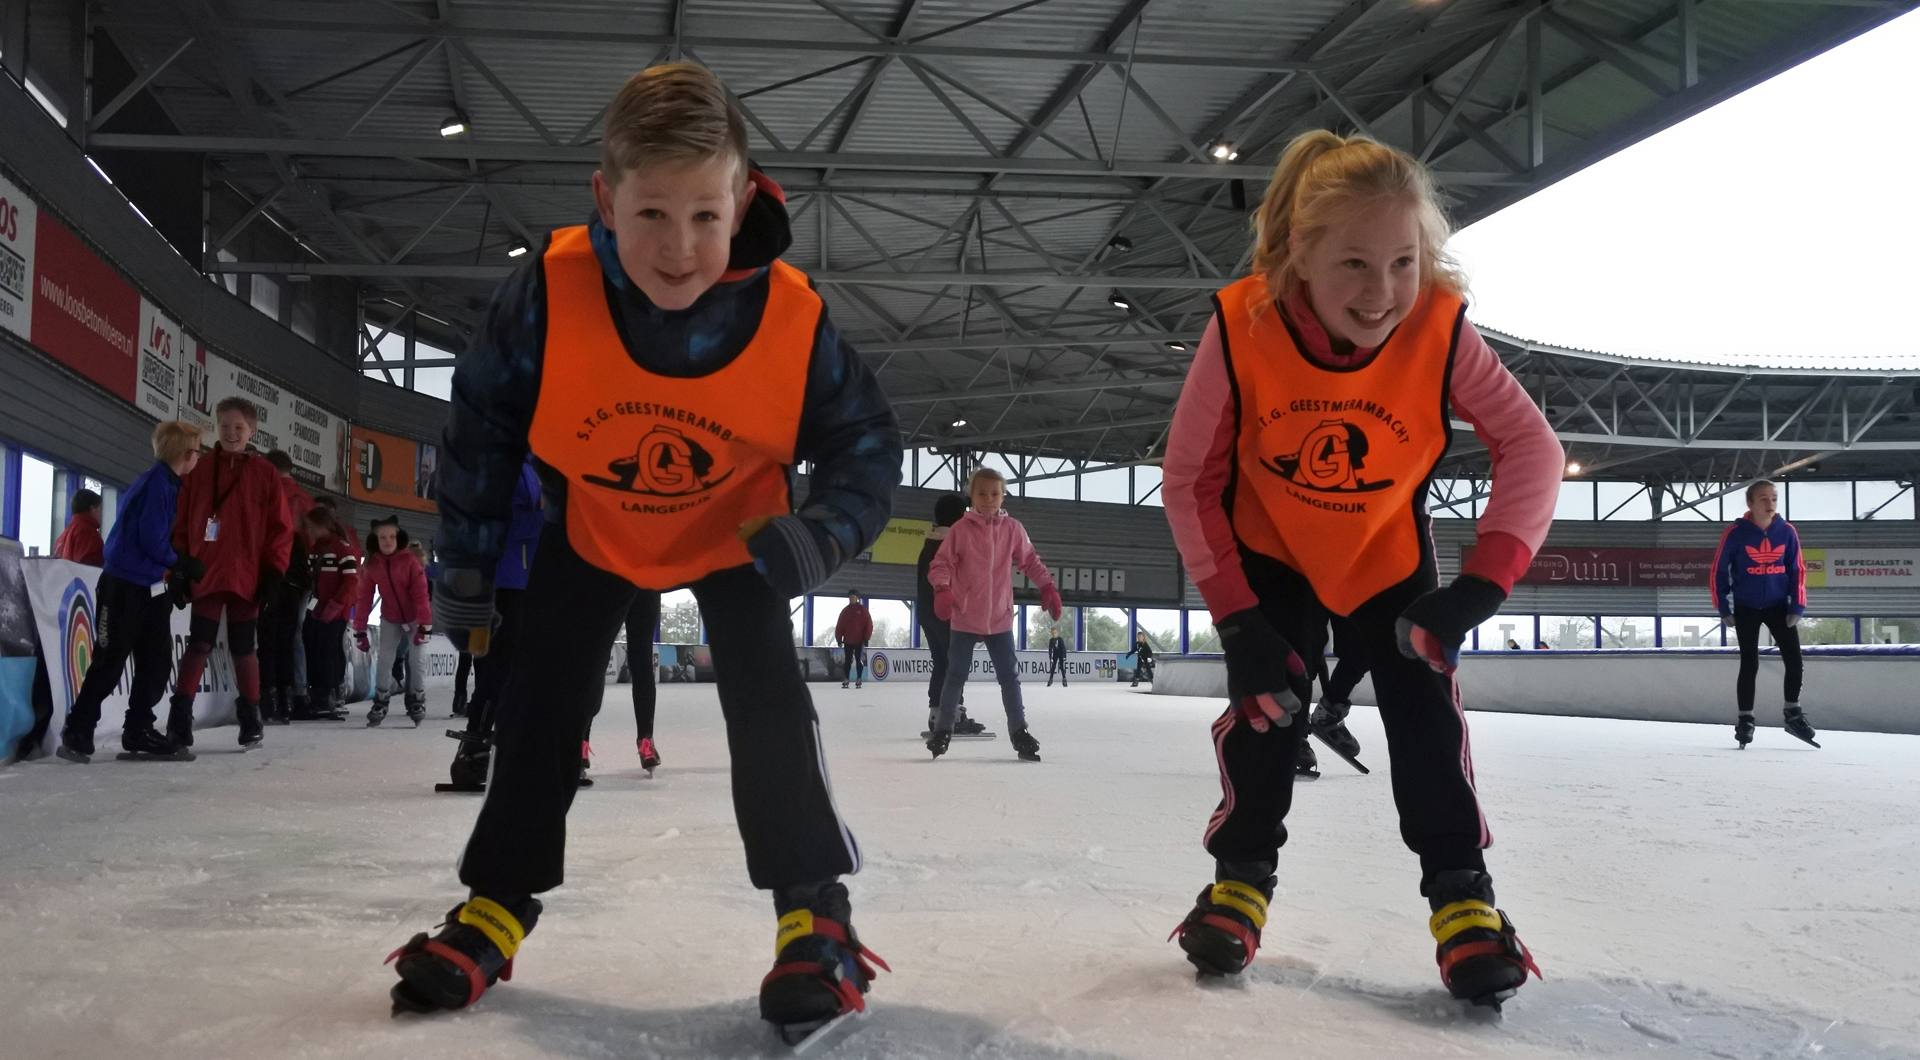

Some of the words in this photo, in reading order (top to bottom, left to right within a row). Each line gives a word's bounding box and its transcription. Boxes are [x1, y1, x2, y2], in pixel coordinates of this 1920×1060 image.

[41, 274, 134, 358] www.loosbetonvloeren.nl
[1289, 398, 1410, 444] GEESTMERAMBACHT
[293, 444, 303, 462] FULL
[1286, 486, 1367, 514] LANGEDIJK
[1653, 562, 1682, 571] waardig
[1746, 564, 1786, 576] adidas
[1835, 568, 1913, 576] BETONSTAAL
[1669, 572, 1696, 580] budget
